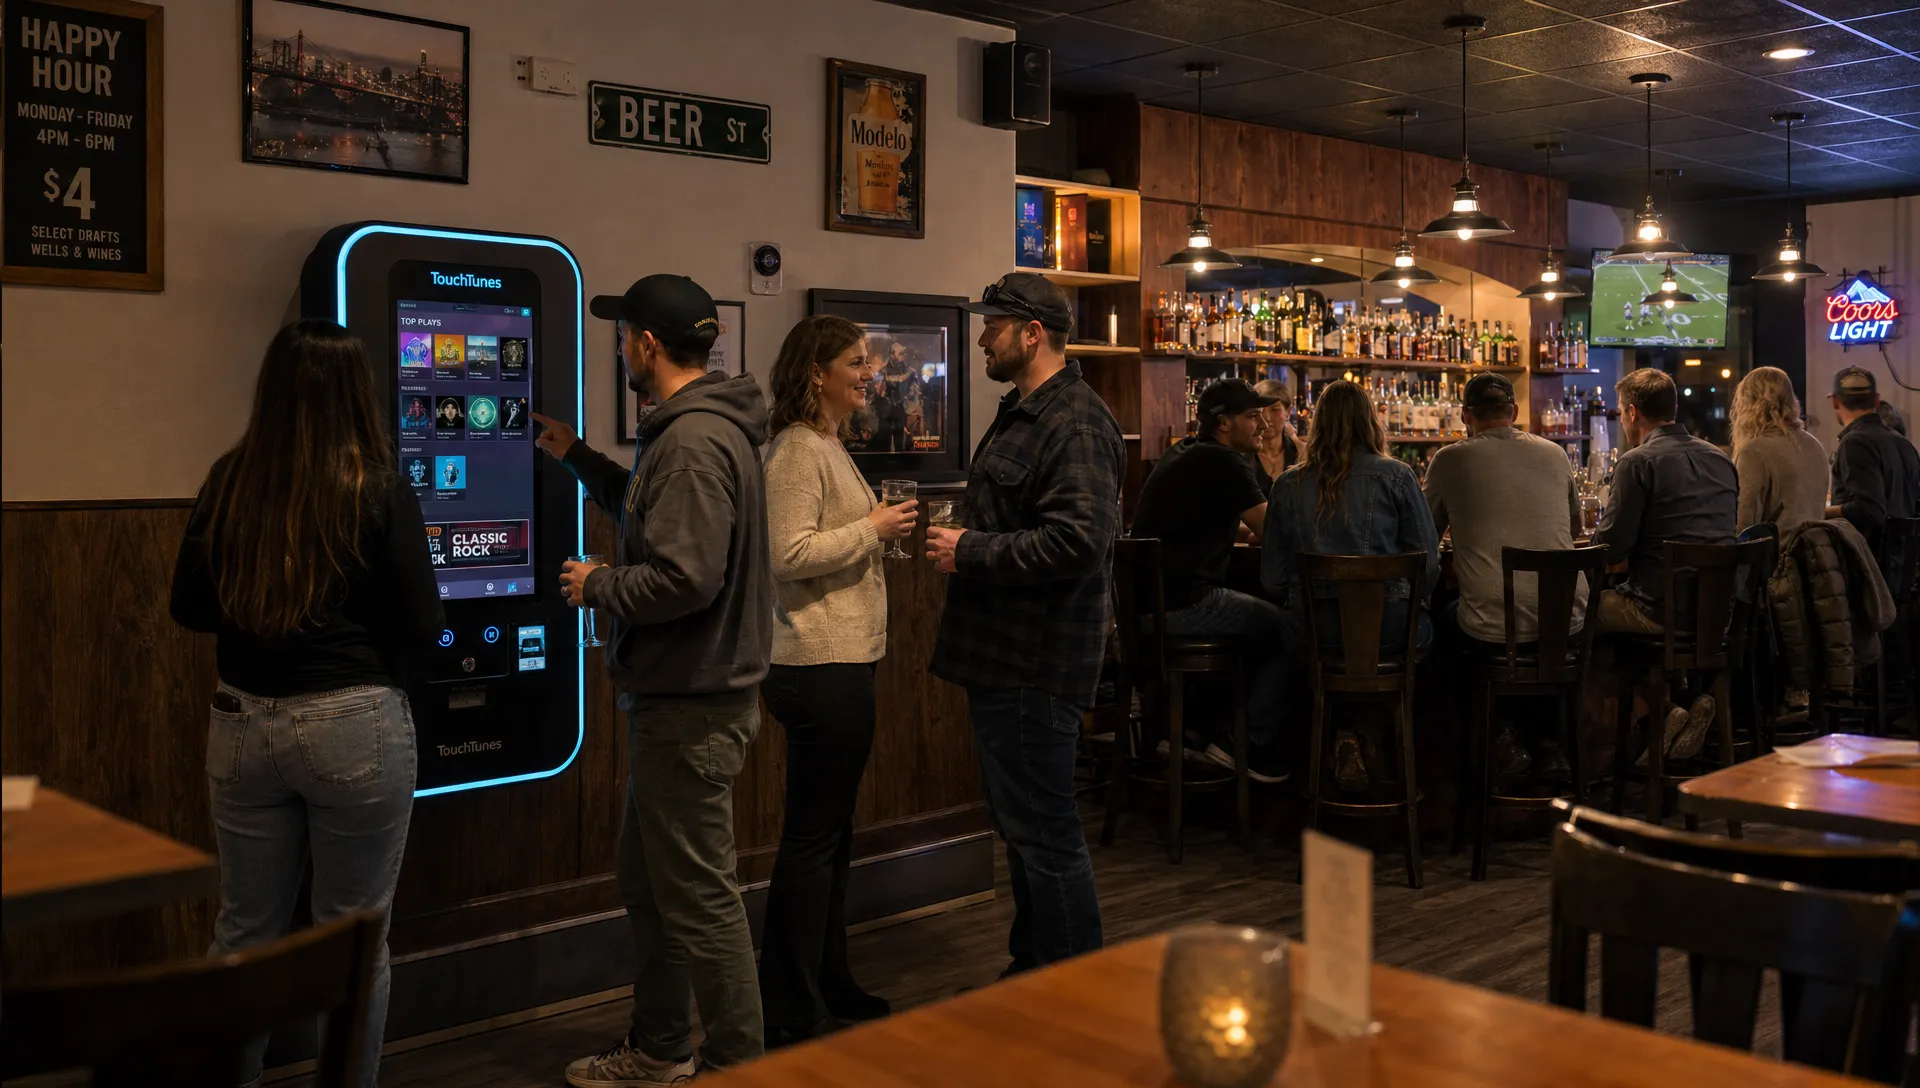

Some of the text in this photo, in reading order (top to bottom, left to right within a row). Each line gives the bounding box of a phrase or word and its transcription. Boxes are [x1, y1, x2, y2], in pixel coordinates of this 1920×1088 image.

[22, 16, 121, 60] HAPPY
[33, 55, 112, 97] HOUR
[18, 102, 75, 122] MONDAY
[87, 110, 133, 129] FRIDAY
[619, 95, 747, 147] BEER ST
[37, 128, 69, 147] 4PM
[85, 133, 115, 152] 6PM
[851, 119, 907, 151] Modelo
[43, 167, 96, 220] $4
[32, 225, 120, 243] SELECT DRAFTS
[31, 244, 122, 260] WELLS & WINES
[430, 271, 502, 289] TouchTunes
[1826, 294, 1899, 323] Coors
[401, 317, 442, 327] TOP PLAYS
[1829, 320, 1893, 340] LIGHT
[452, 532, 508, 546] CLASSIC
[453, 544, 491, 557] ROCK
[436, 740, 502, 757] TouchTunes
